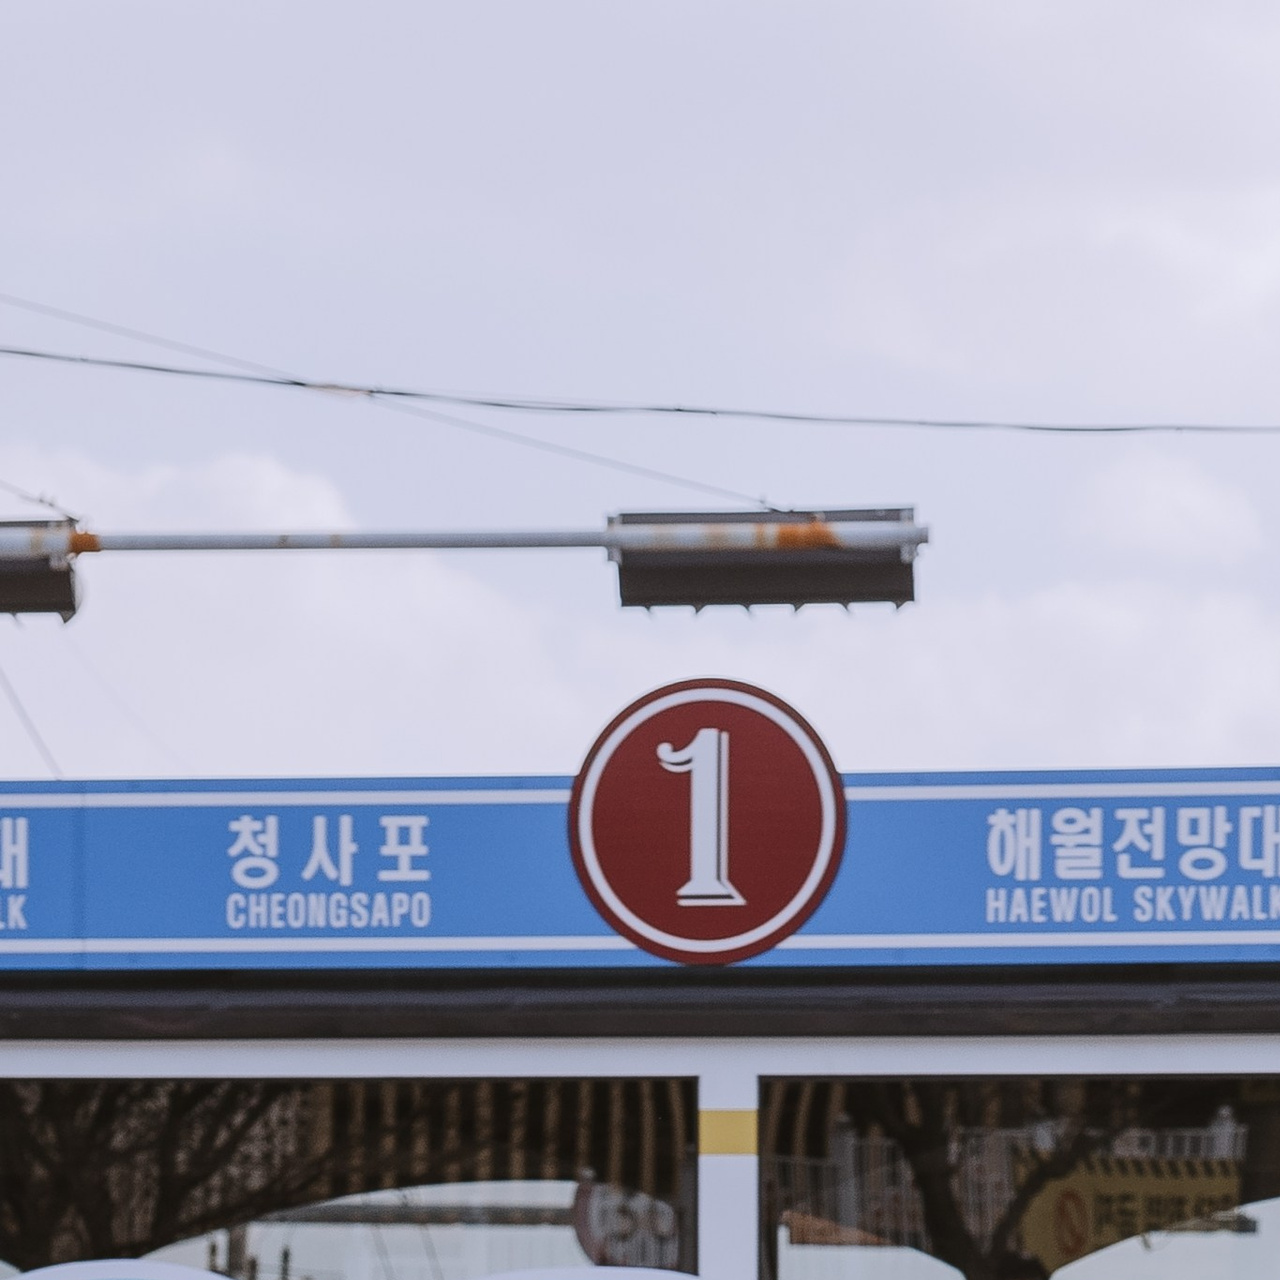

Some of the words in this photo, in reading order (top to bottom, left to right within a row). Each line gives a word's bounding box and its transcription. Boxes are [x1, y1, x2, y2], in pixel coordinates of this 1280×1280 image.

[656, 727, 747, 906] 1
[227, 814, 431, 889] 청사포
[226, 891, 431, 929] CHEONGSAPO
[986, 886, 1118, 923] HAEWOL
